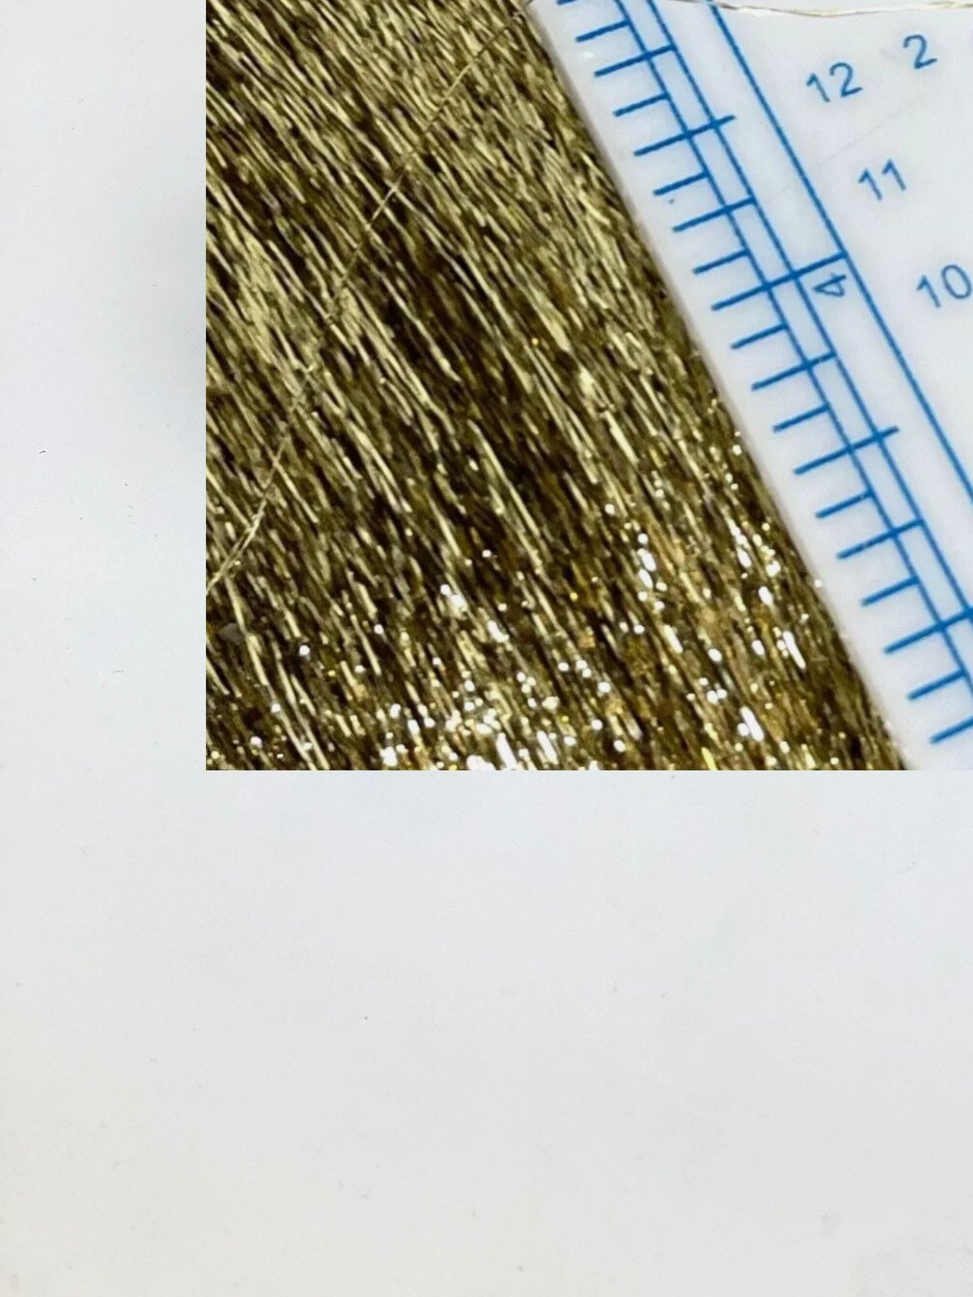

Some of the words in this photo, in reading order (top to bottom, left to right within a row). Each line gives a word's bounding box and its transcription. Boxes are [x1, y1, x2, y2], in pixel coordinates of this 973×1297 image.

[806, 62, 862, 101] 12
[903, 34, 936, 69] 2
[858, 159, 906, 200] 11
[812, 270, 847, 297] 4
[917, 263, 973, 307] 10
